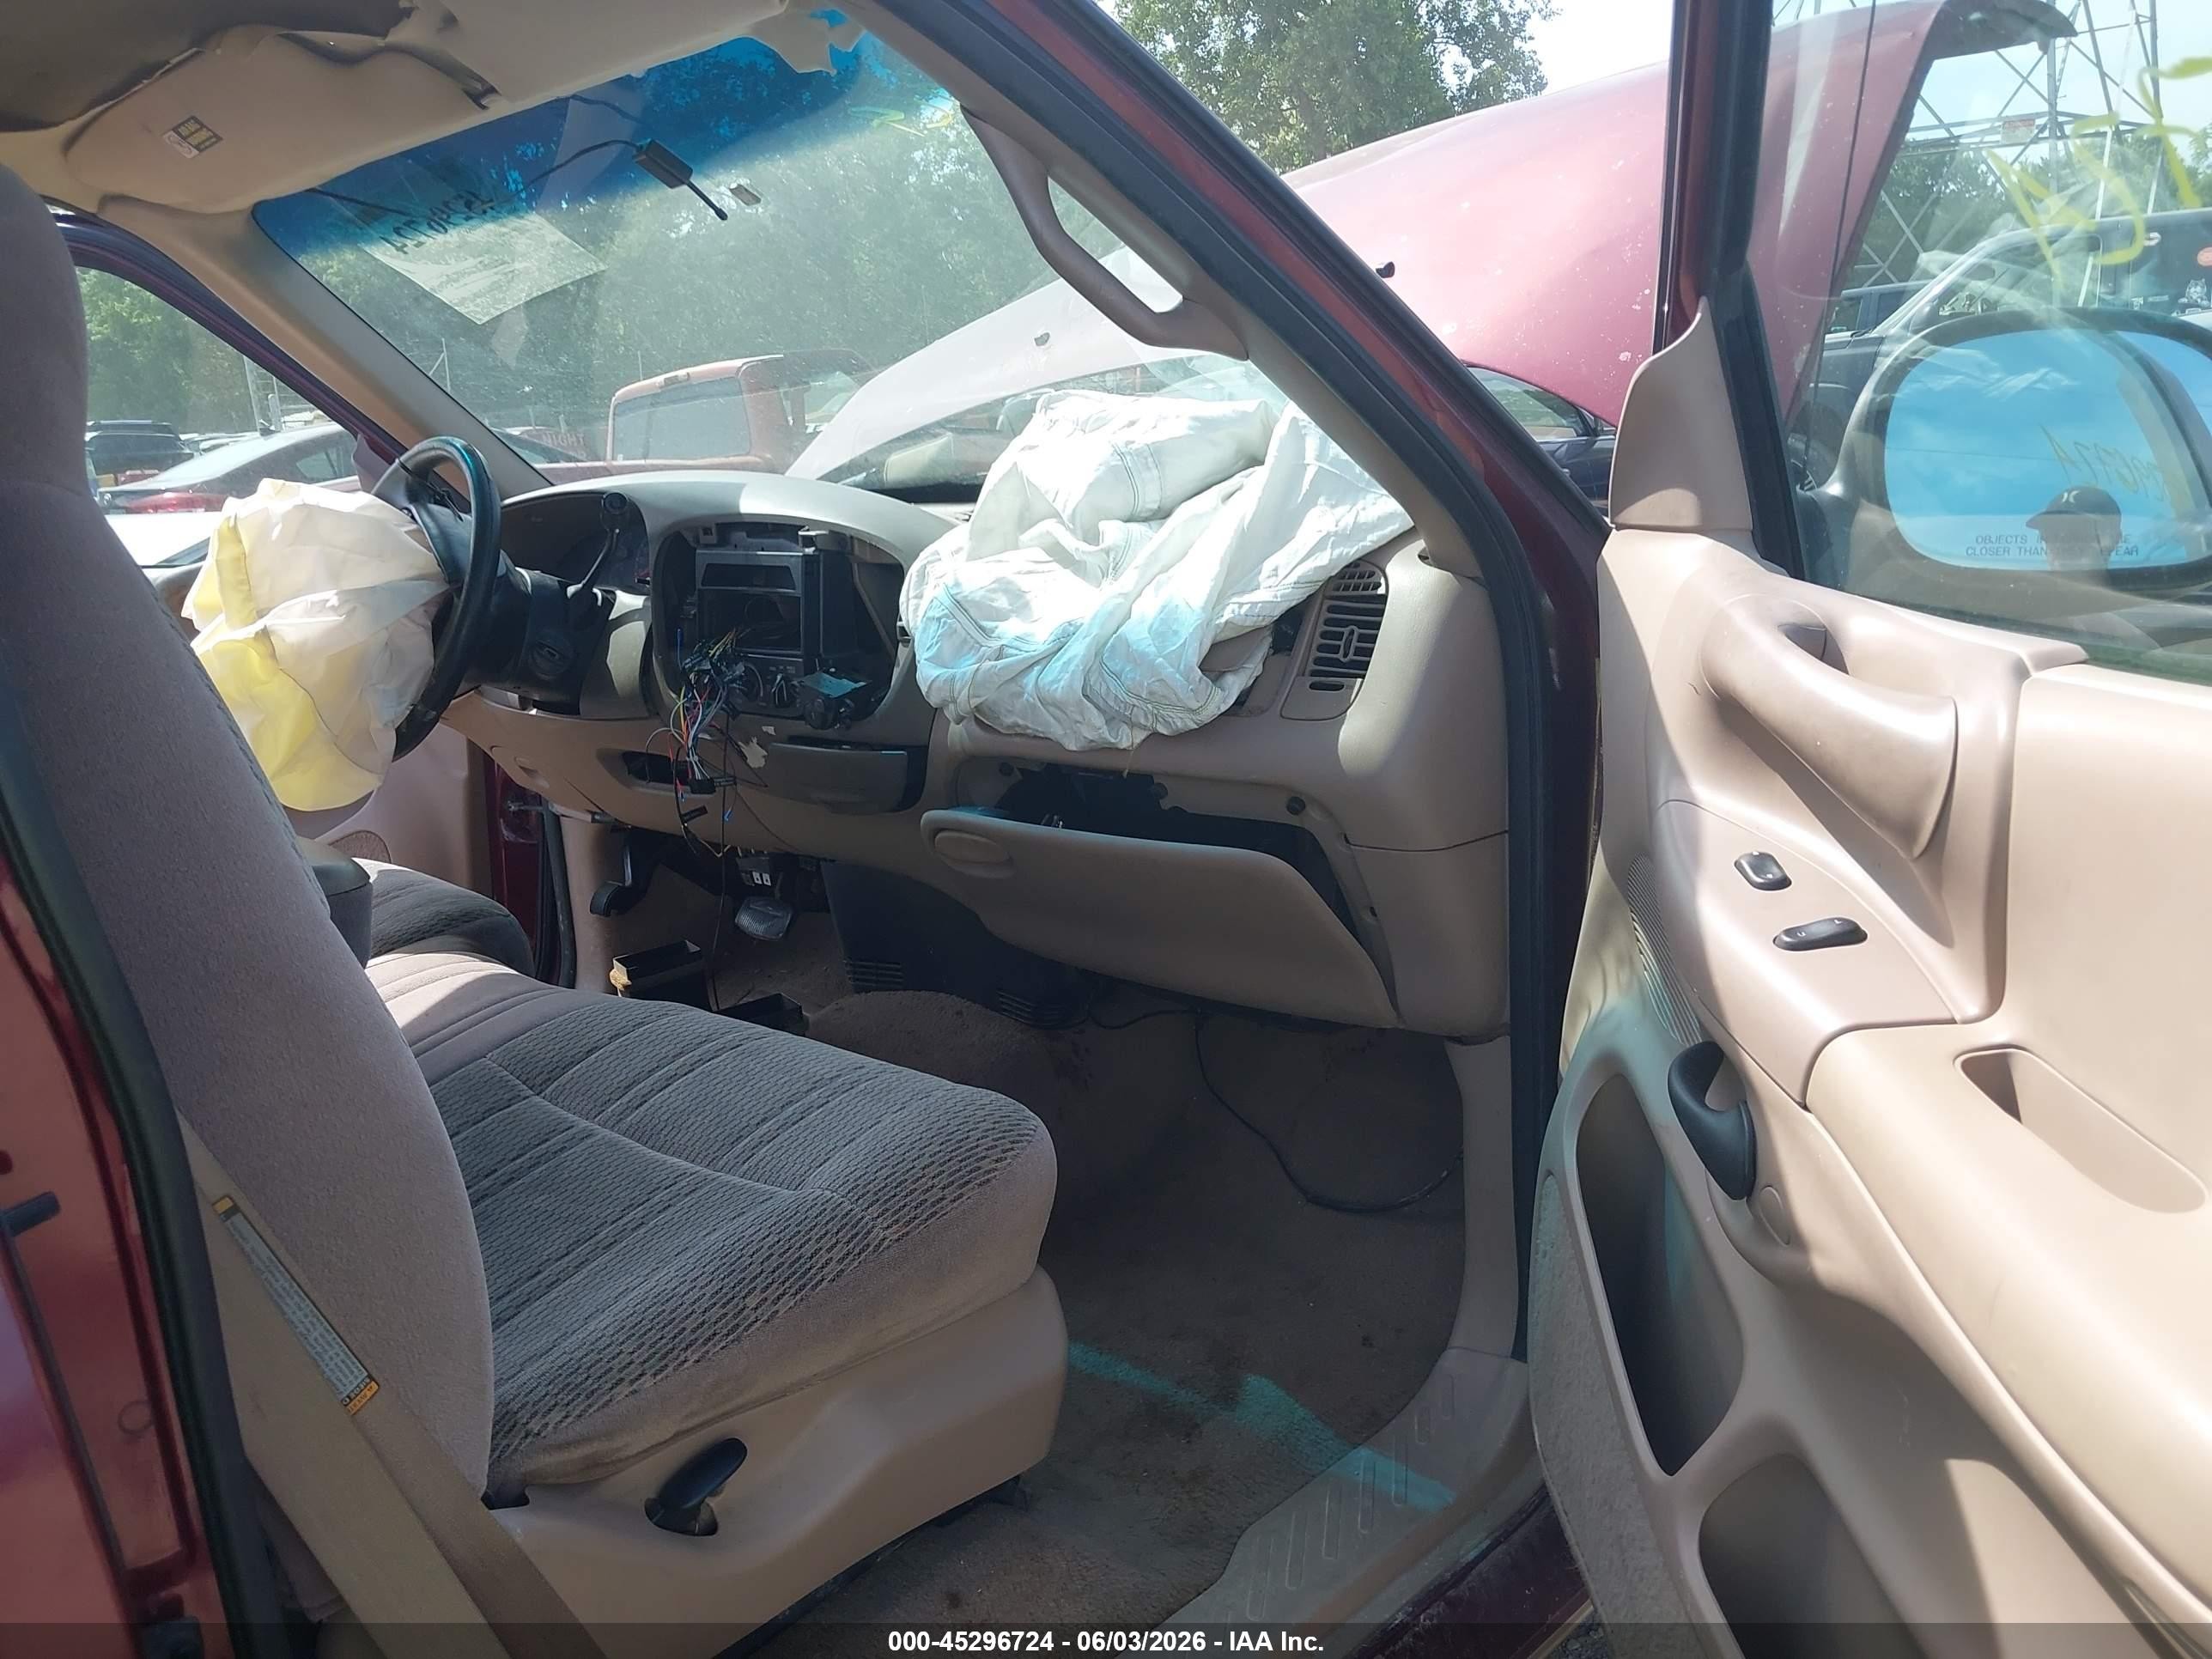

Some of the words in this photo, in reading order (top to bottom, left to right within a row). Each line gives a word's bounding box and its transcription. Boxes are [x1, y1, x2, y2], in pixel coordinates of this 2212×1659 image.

[1975, 534, 2028, 545] OBJECTS
[1966, 545, 2011, 557] CLOSER
[2018, 545, 2048, 557] THAN
